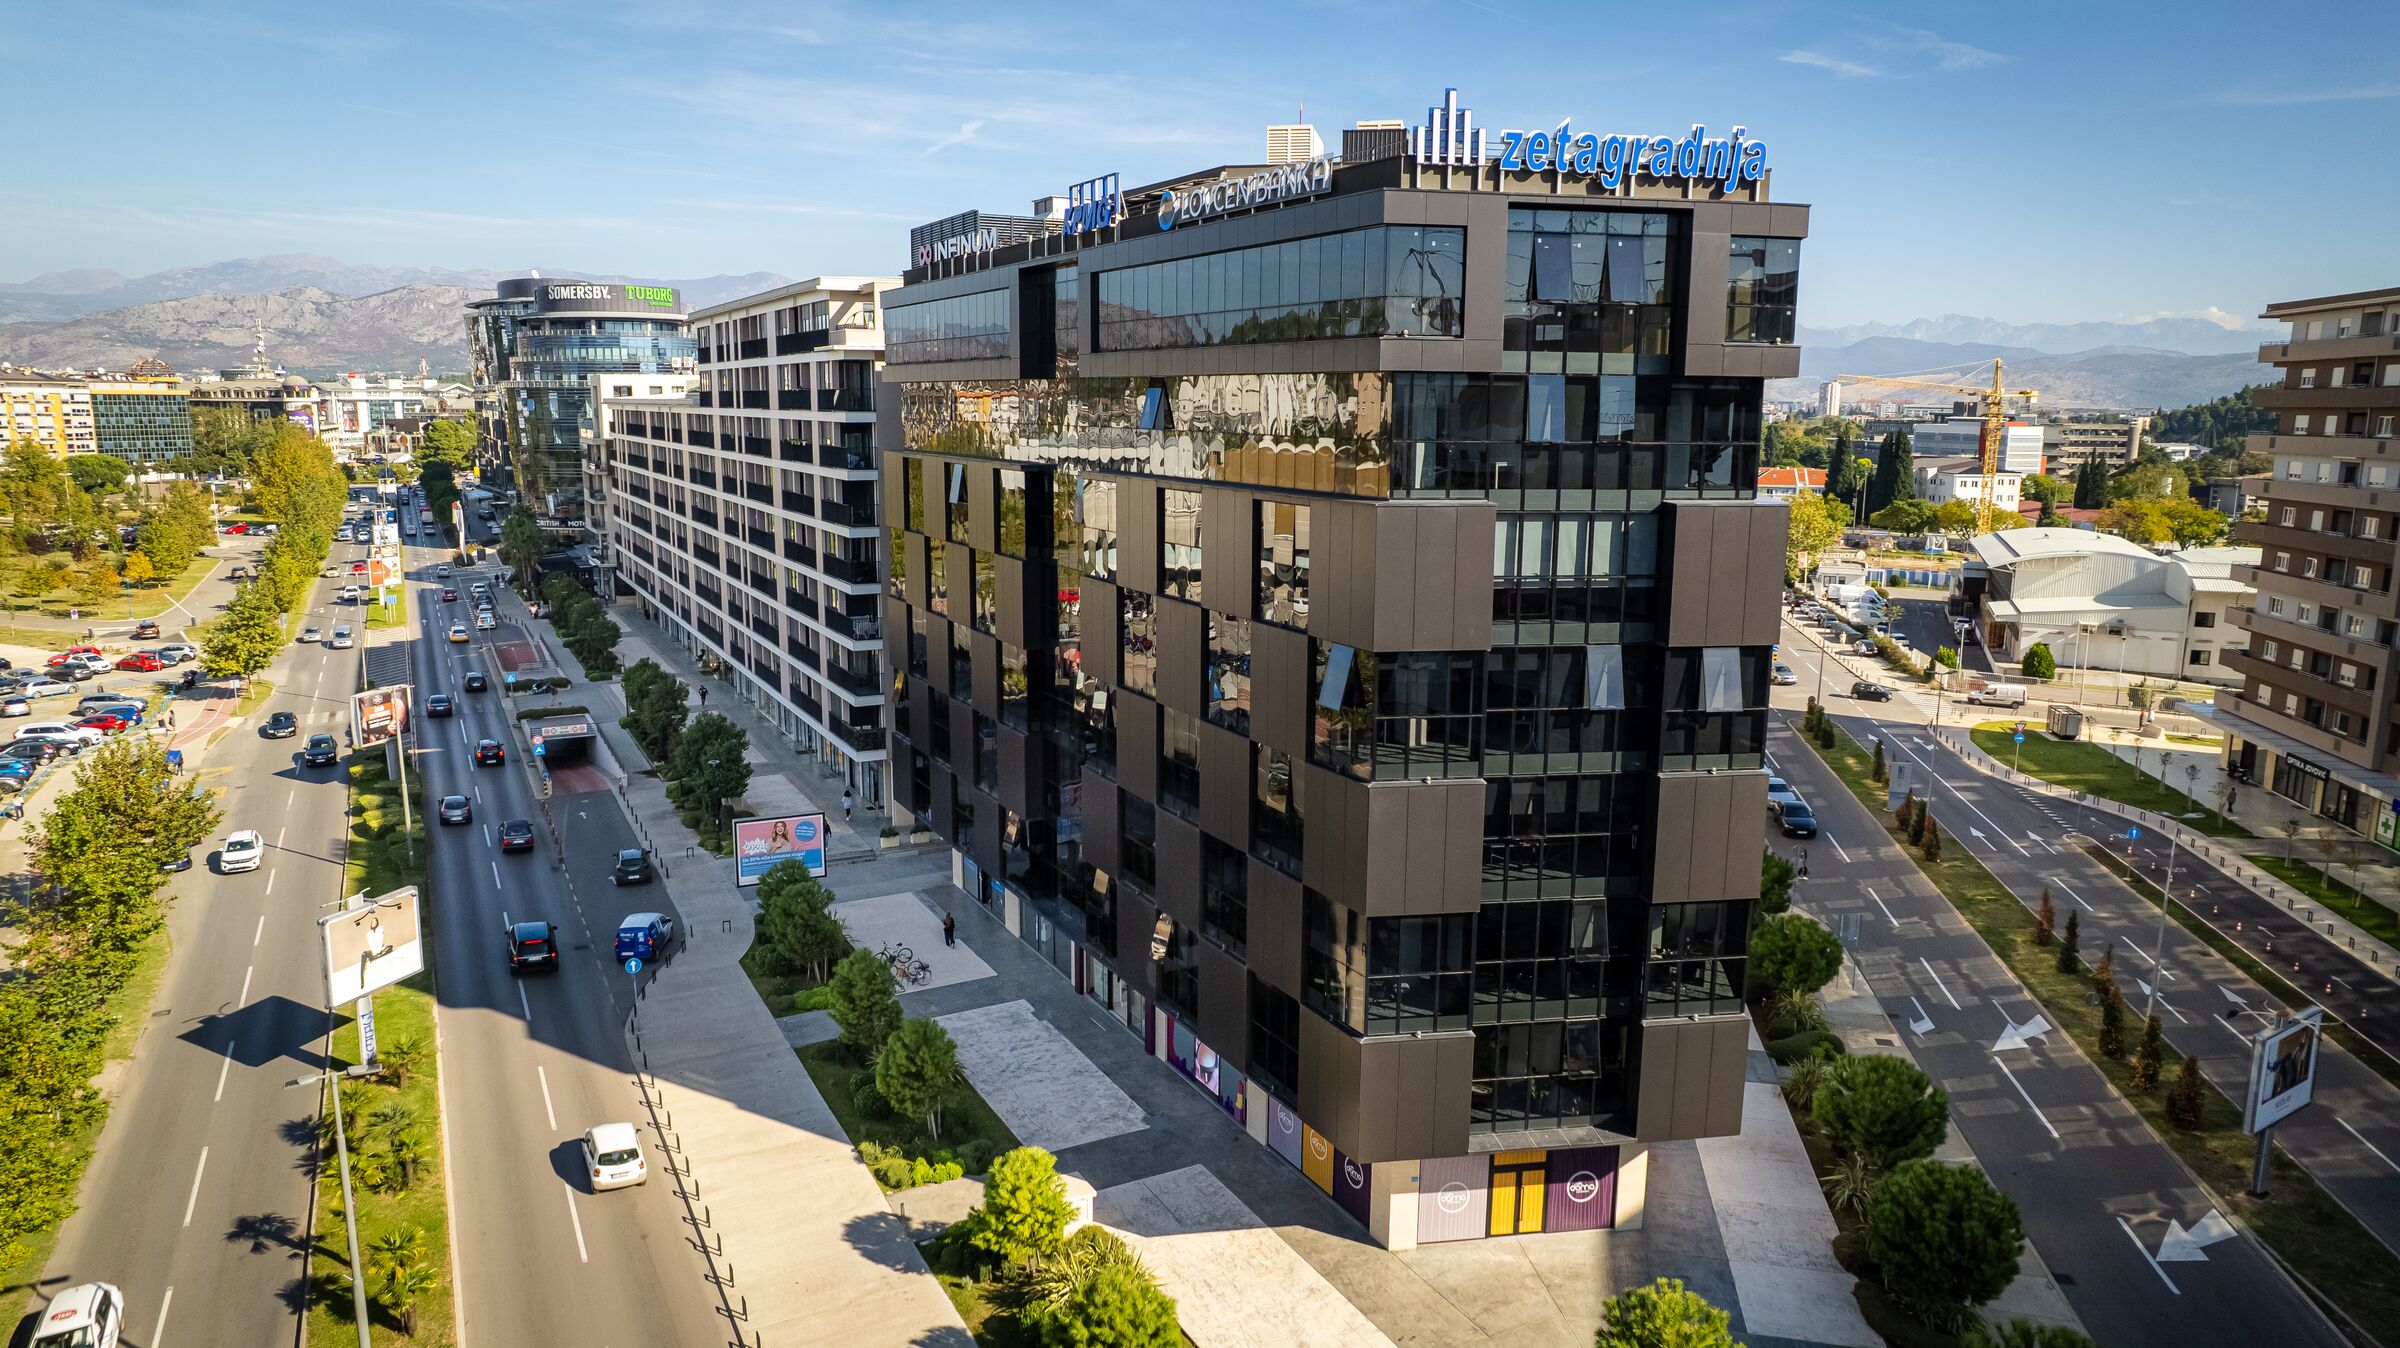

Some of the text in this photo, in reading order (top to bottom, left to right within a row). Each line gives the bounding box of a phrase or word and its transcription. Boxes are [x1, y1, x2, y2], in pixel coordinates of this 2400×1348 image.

[1499, 117, 1768, 194] zetagradnja
[1255, 159, 1329, 203] BANKA
[1063, 196, 1114, 236] KPMG
[934, 227, 999, 262] INFINUM
[624, 285, 673, 302] TUBORG
[2287, 756, 2304, 769] OPTIKA
